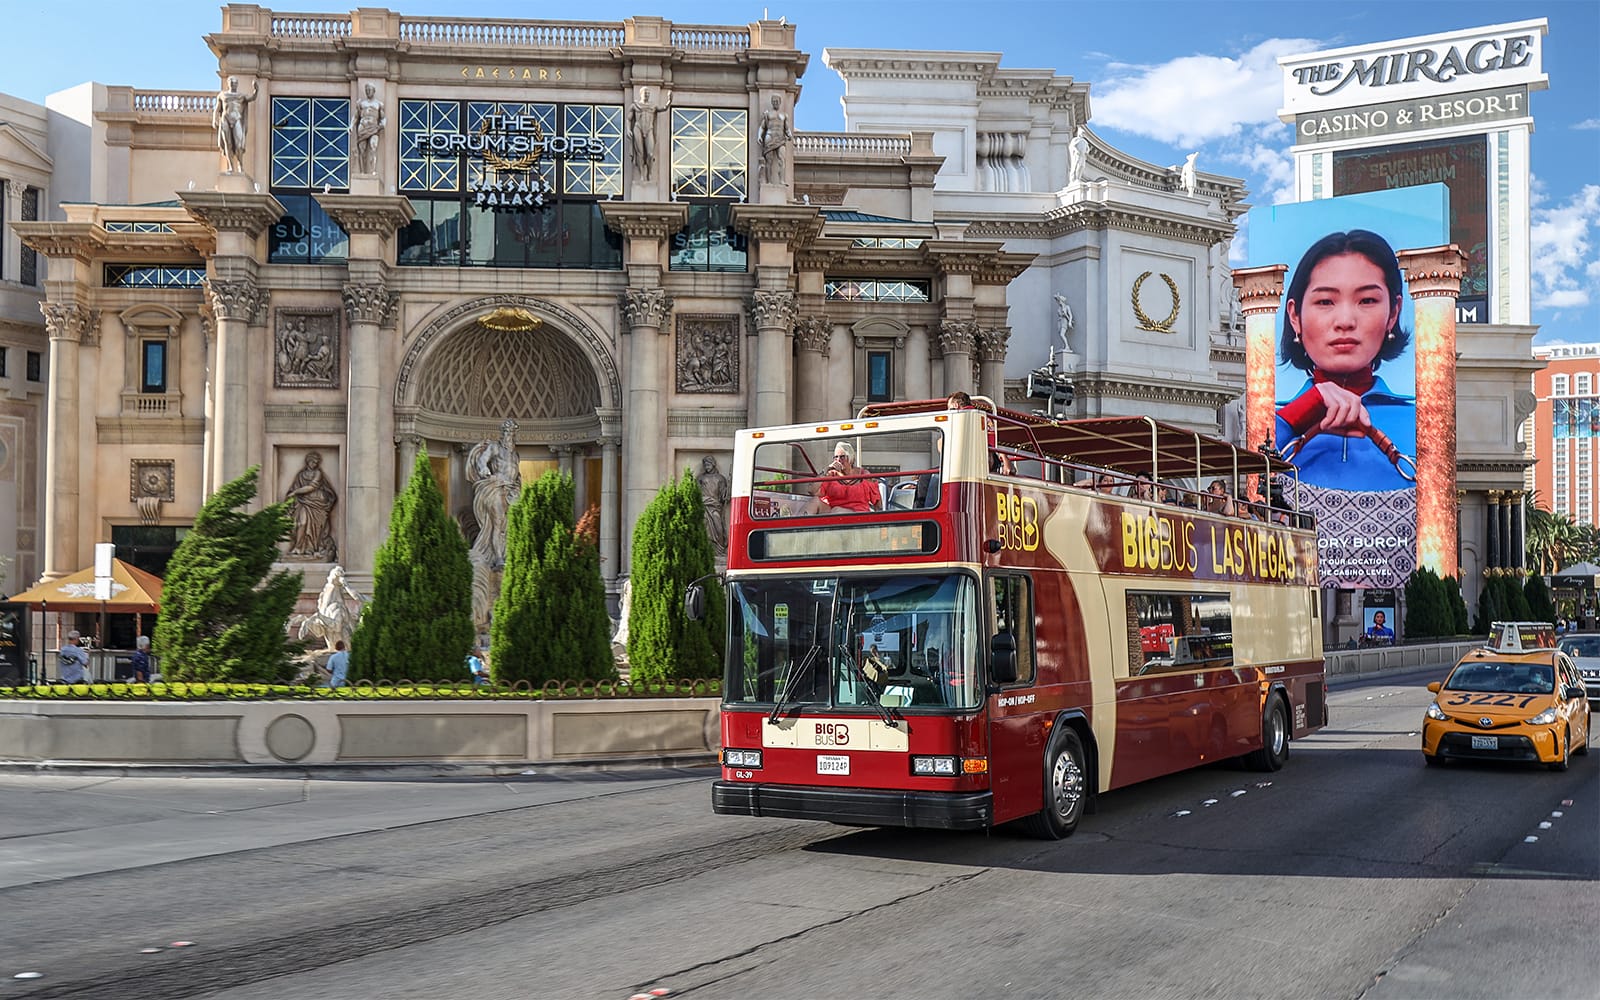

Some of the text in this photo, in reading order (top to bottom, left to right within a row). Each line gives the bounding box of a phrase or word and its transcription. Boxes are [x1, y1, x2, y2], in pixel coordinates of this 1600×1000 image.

[461, 67, 563, 81] CAESARS
[1292, 35, 1534, 96] THE MIRAGE
[485, 114, 535, 131] THE
[1301, 93, 1523, 137] CASINO & RESORT
[414, 133, 605, 154] FORUM SHOPS
[1369, 157, 1417, 179] SEVEN
[1385, 165, 1456, 189] MINIMUM
[470, 180, 551, 193] CAESARS
[476, 192, 544, 206] PALACE
[280, 242, 343, 256] ROKU
[997, 492, 1021, 524] BIG
[999, 521, 1022, 551] BUS
[1353, 536, 1409, 548] BURCH
[1211, 526, 1245, 577] LAS
[1247, 530, 1295, 580] VEGAS
[1447, 692, 1538, 709] 3227
[815, 723, 834, 735] BIG
[815, 735, 834, 745] BUS
[736, 770, 753, 779] GL-39
